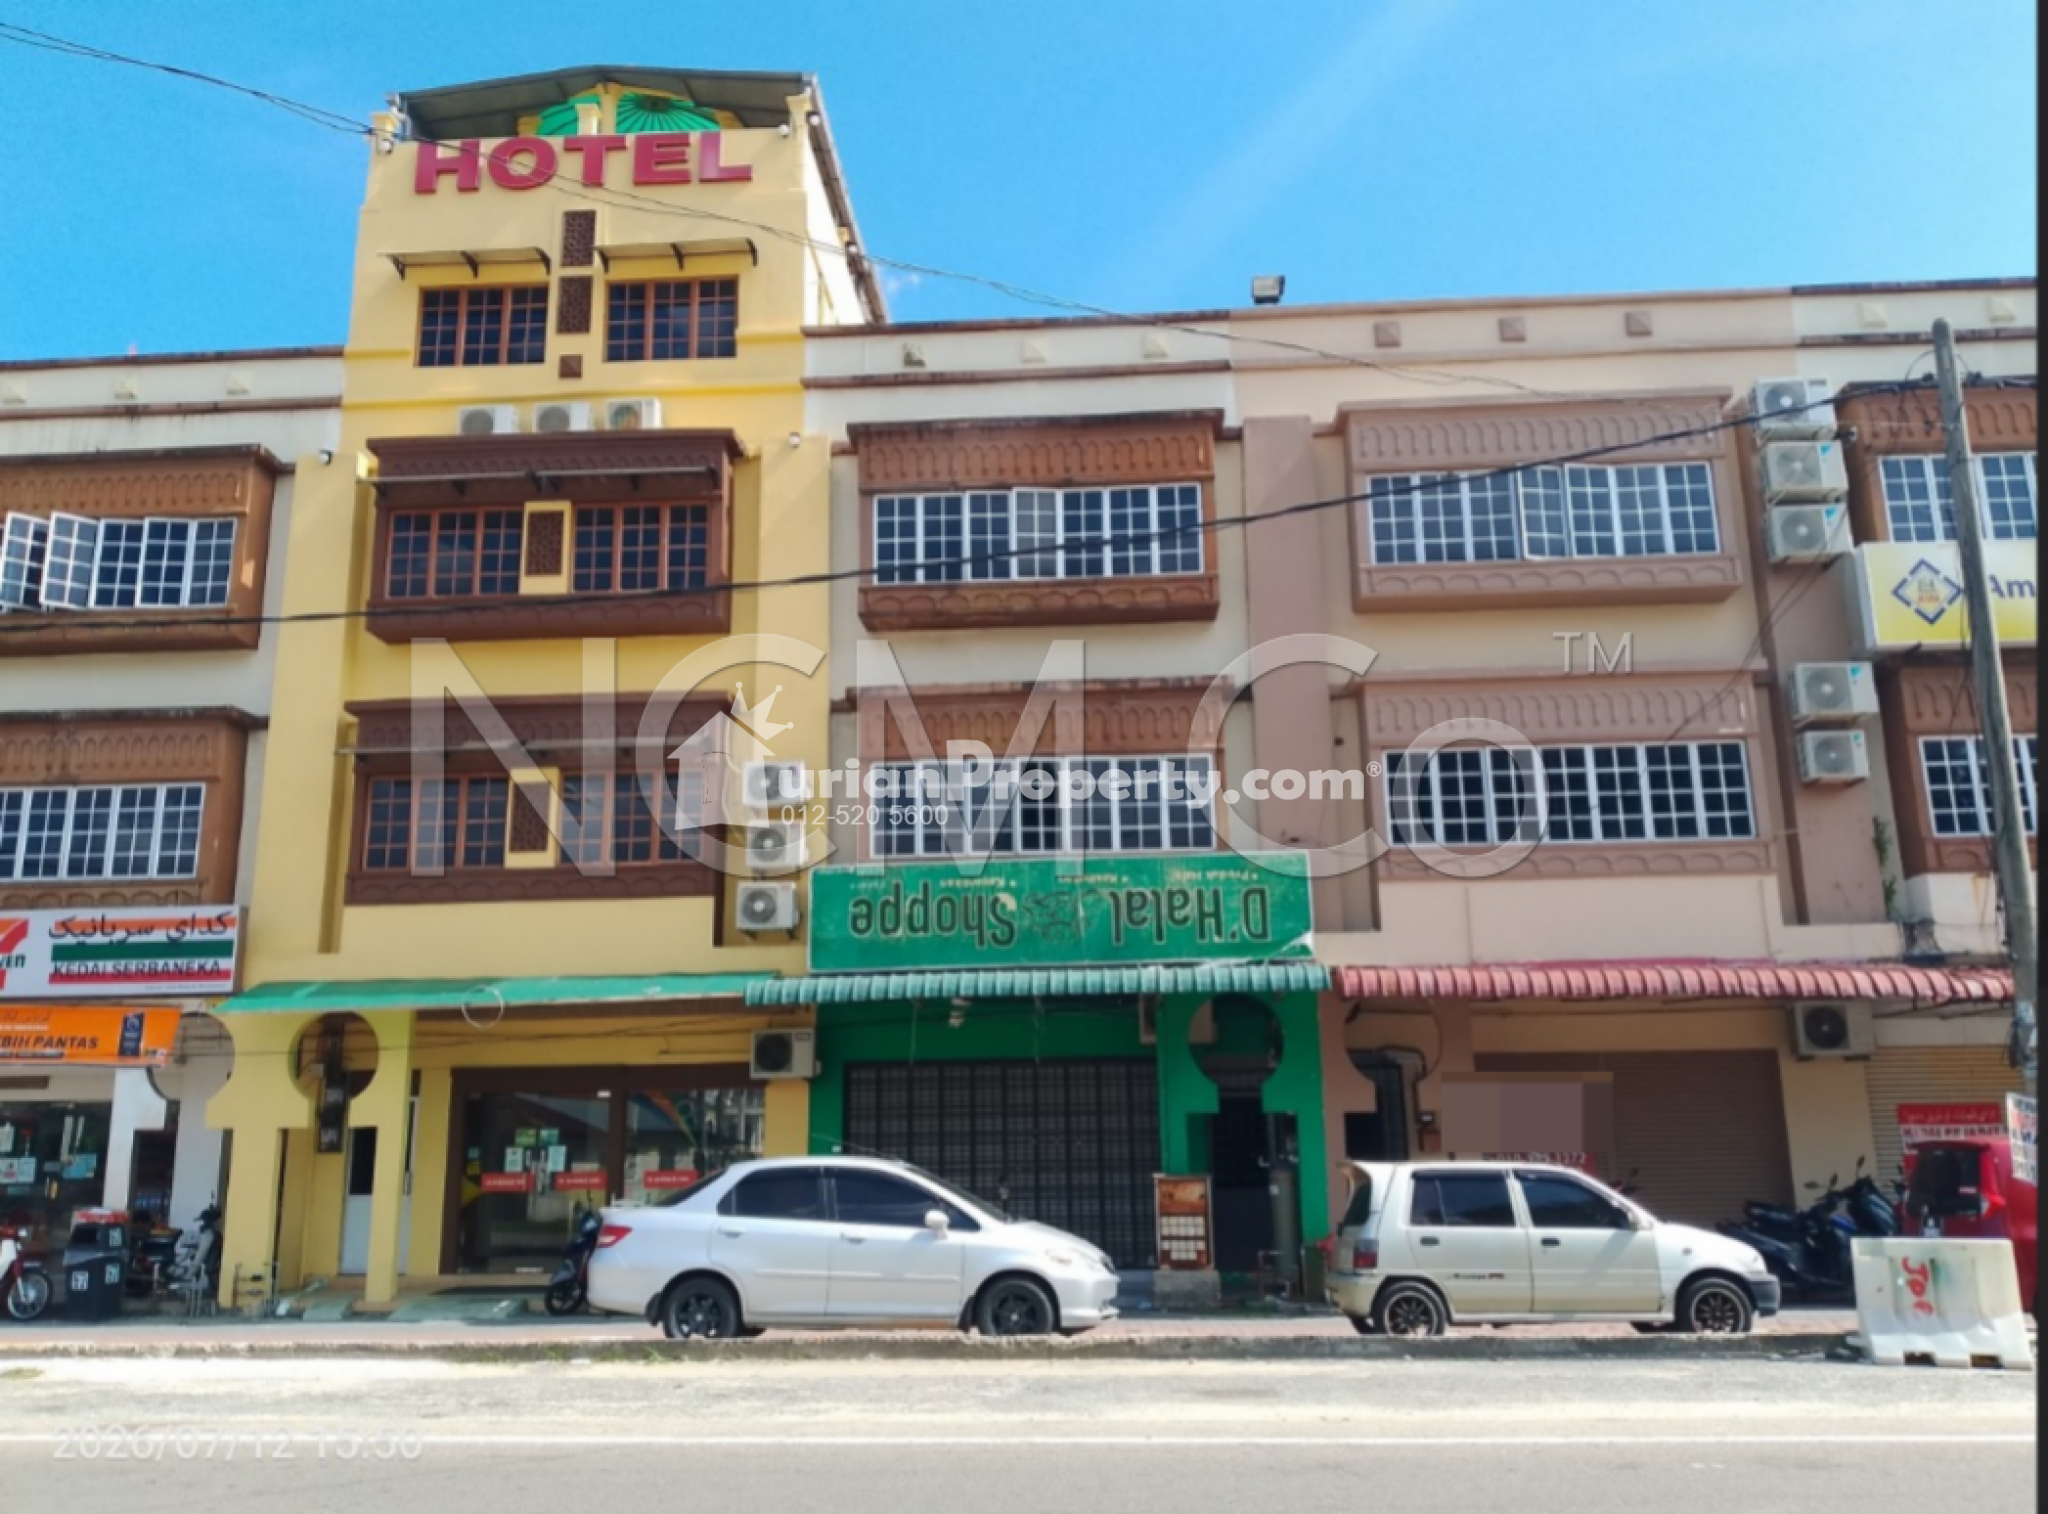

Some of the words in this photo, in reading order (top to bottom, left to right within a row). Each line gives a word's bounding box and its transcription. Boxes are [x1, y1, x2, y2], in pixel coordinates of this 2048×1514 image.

[414, 132, 752, 195] HOTEL
[849, 880, 1018, 948] Shoppe
[1109, 883, 1271, 944] D'Halal
[53, 962, 109, 979] KEDAI
[112, 959, 222, 978] SERBANEKA
[0, 1034, 31, 1049] BIH
[34, 1035, 99, 1050] PANTAS
